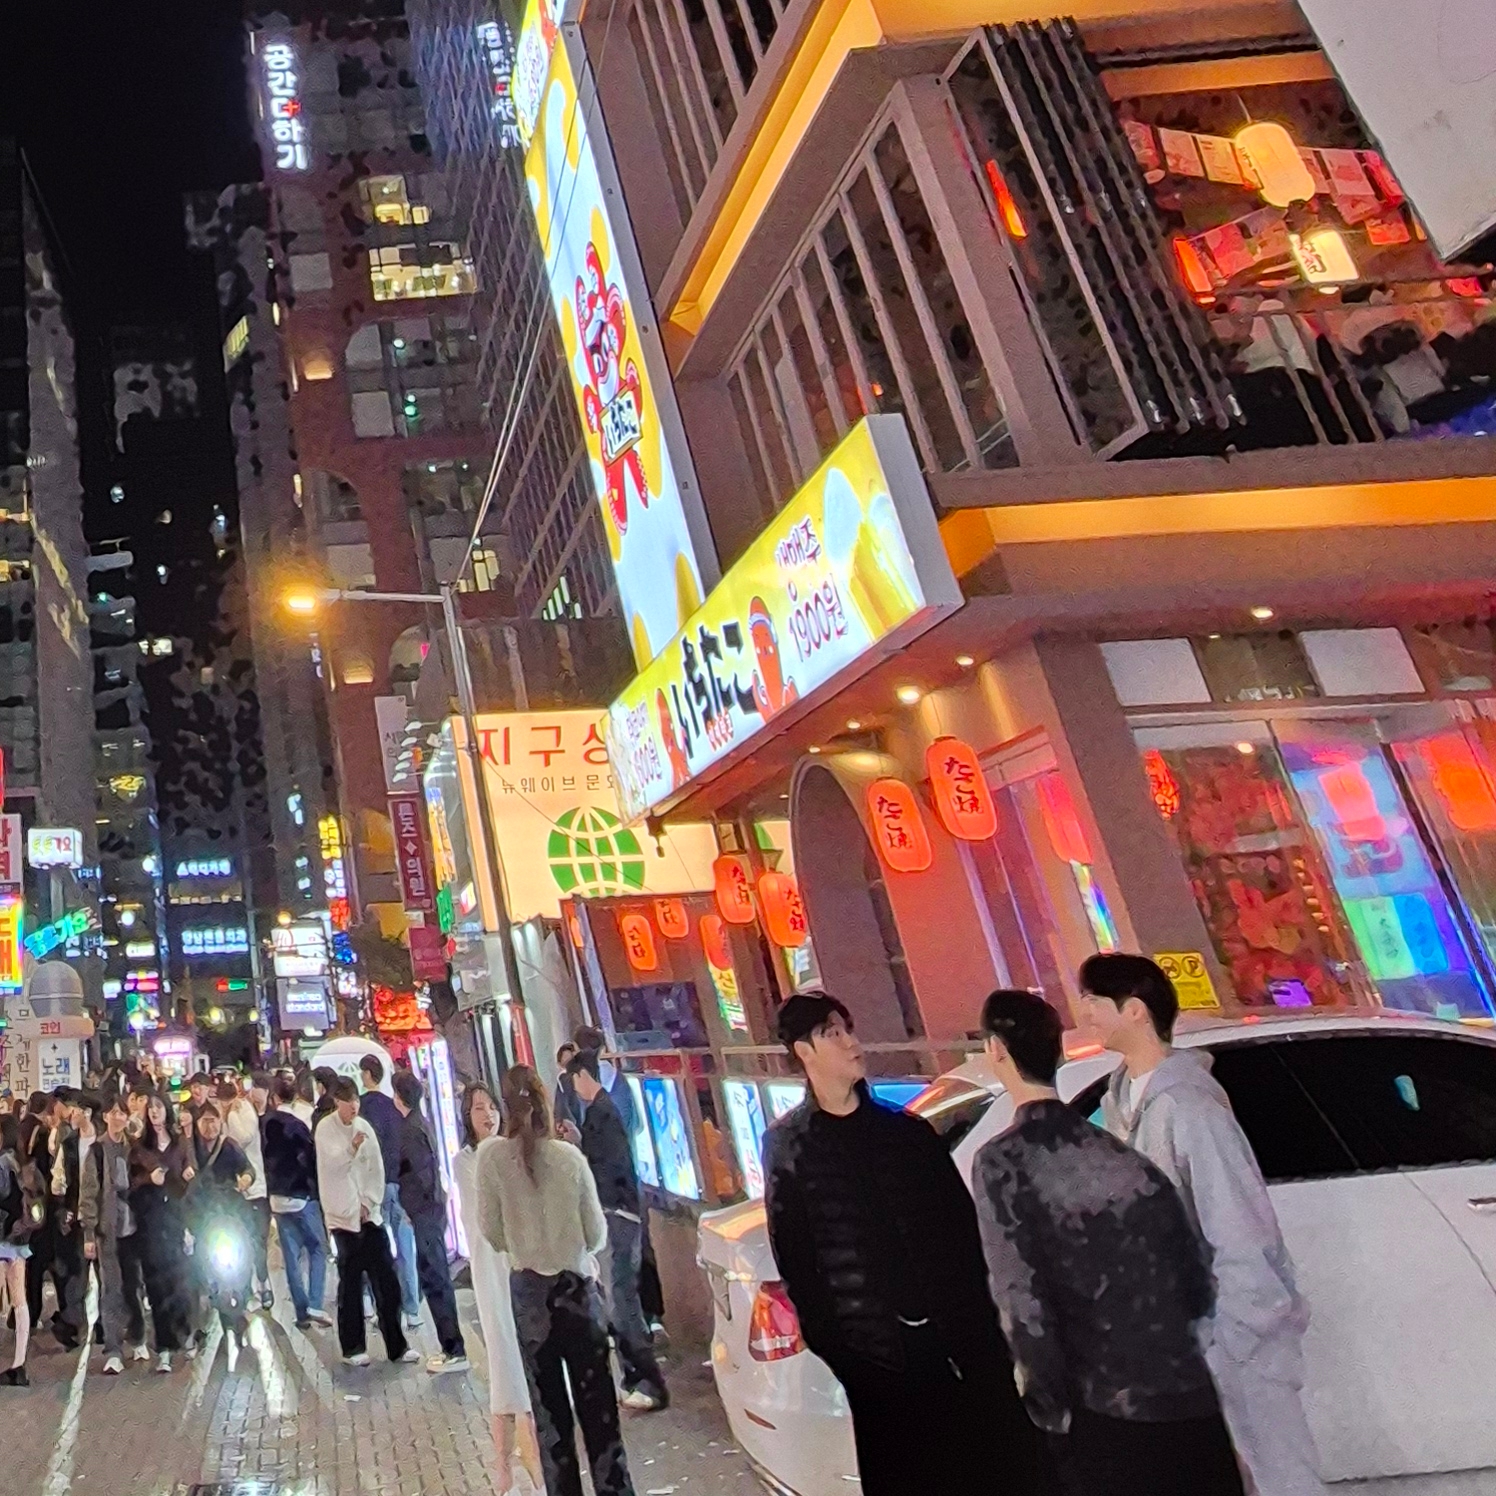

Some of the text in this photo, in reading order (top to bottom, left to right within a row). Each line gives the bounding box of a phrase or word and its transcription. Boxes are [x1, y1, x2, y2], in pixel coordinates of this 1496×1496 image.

[788, 573, 848, 663] 1900원
[671, 621, 760, 759] いちたこ
[40, 1021, 61, 1036] 코인
[43, 1057, 71, 1076] 노래
